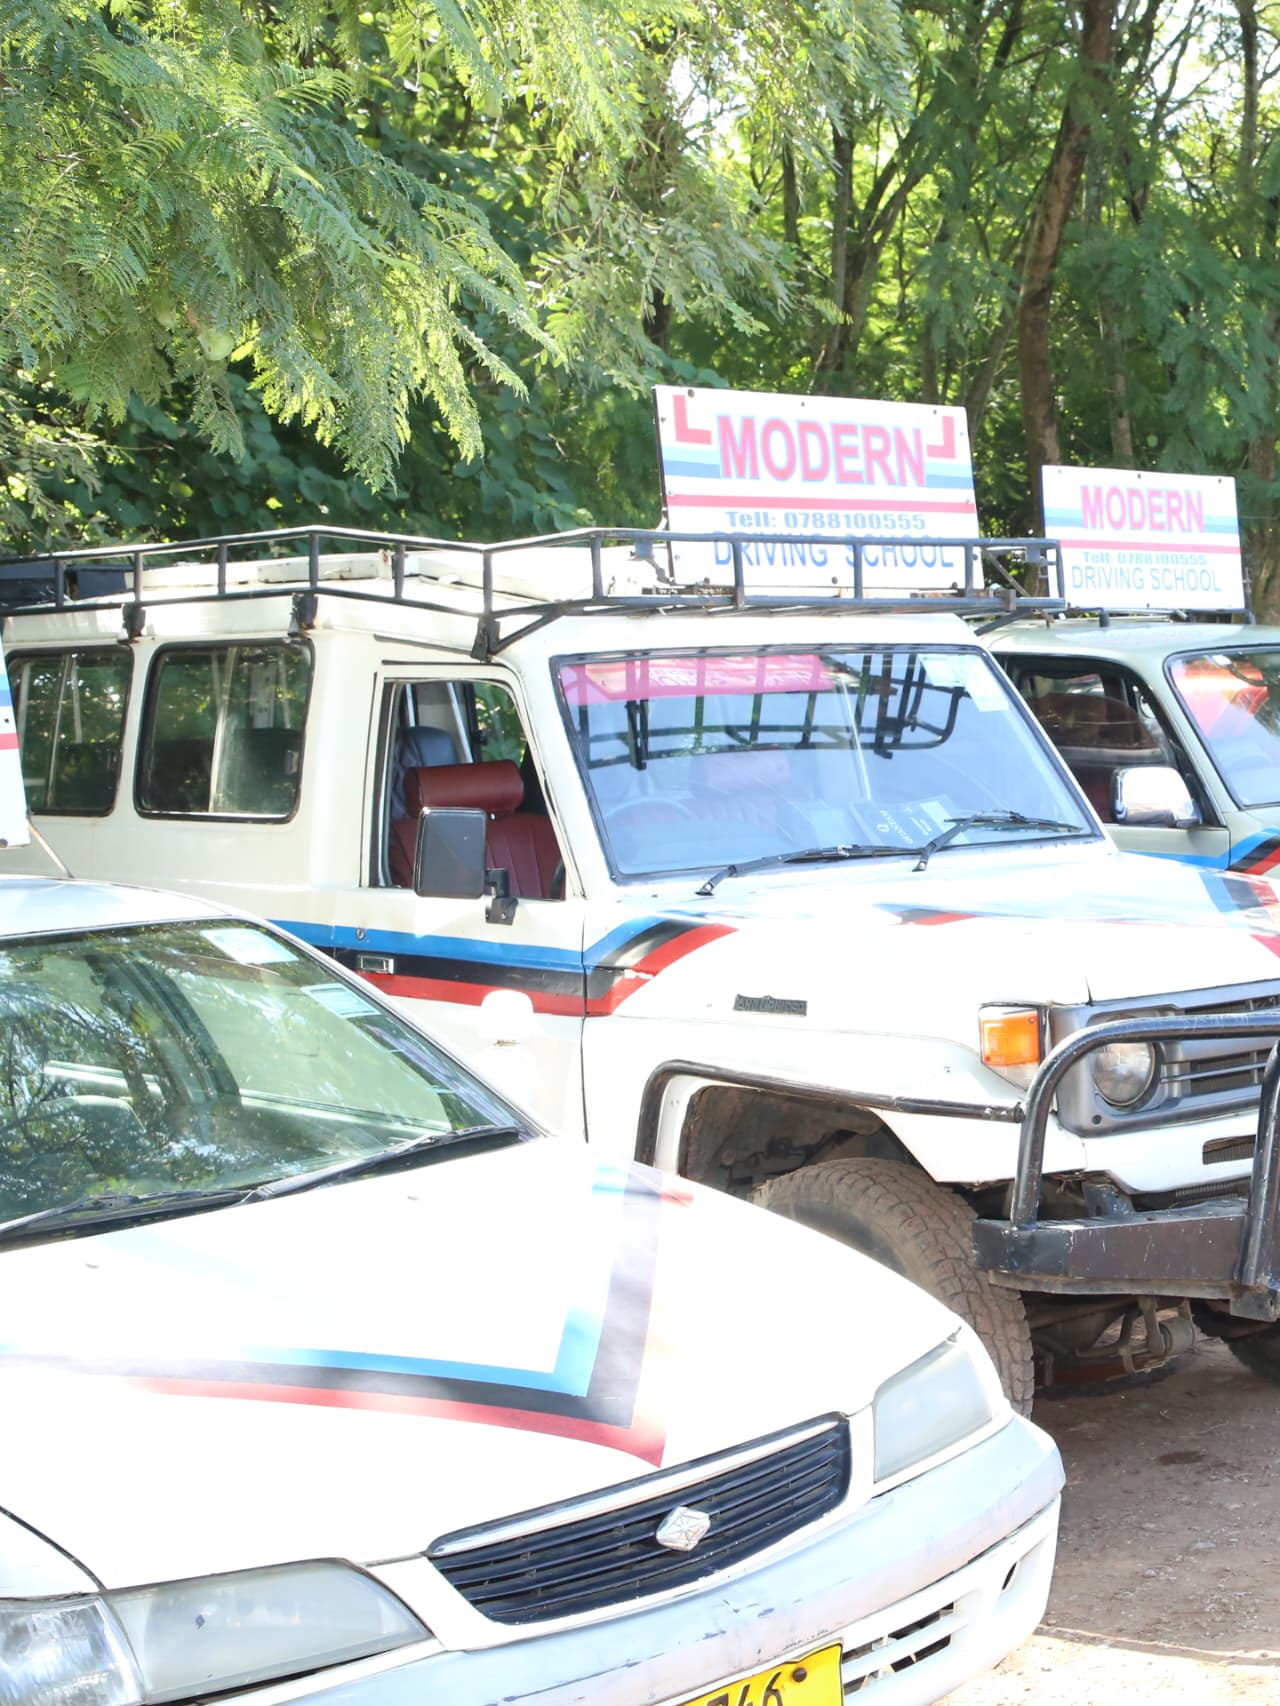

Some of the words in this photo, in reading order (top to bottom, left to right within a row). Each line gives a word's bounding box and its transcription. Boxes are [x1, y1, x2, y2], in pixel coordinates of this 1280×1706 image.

[717, 413, 926, 487] MODERN
[725, 511, 776, 528] Tell:
[784, 511, 926, 530] 0788100555
[1080, 485, 1205, 533] MODERN
[712, 530, 828, 567] DRIVING
[845, 533, 954, 568] SCHOOL
[1071, 566, 1145, 590] DRIVING
[1150, 567, 1223, 593] SCHOOL
